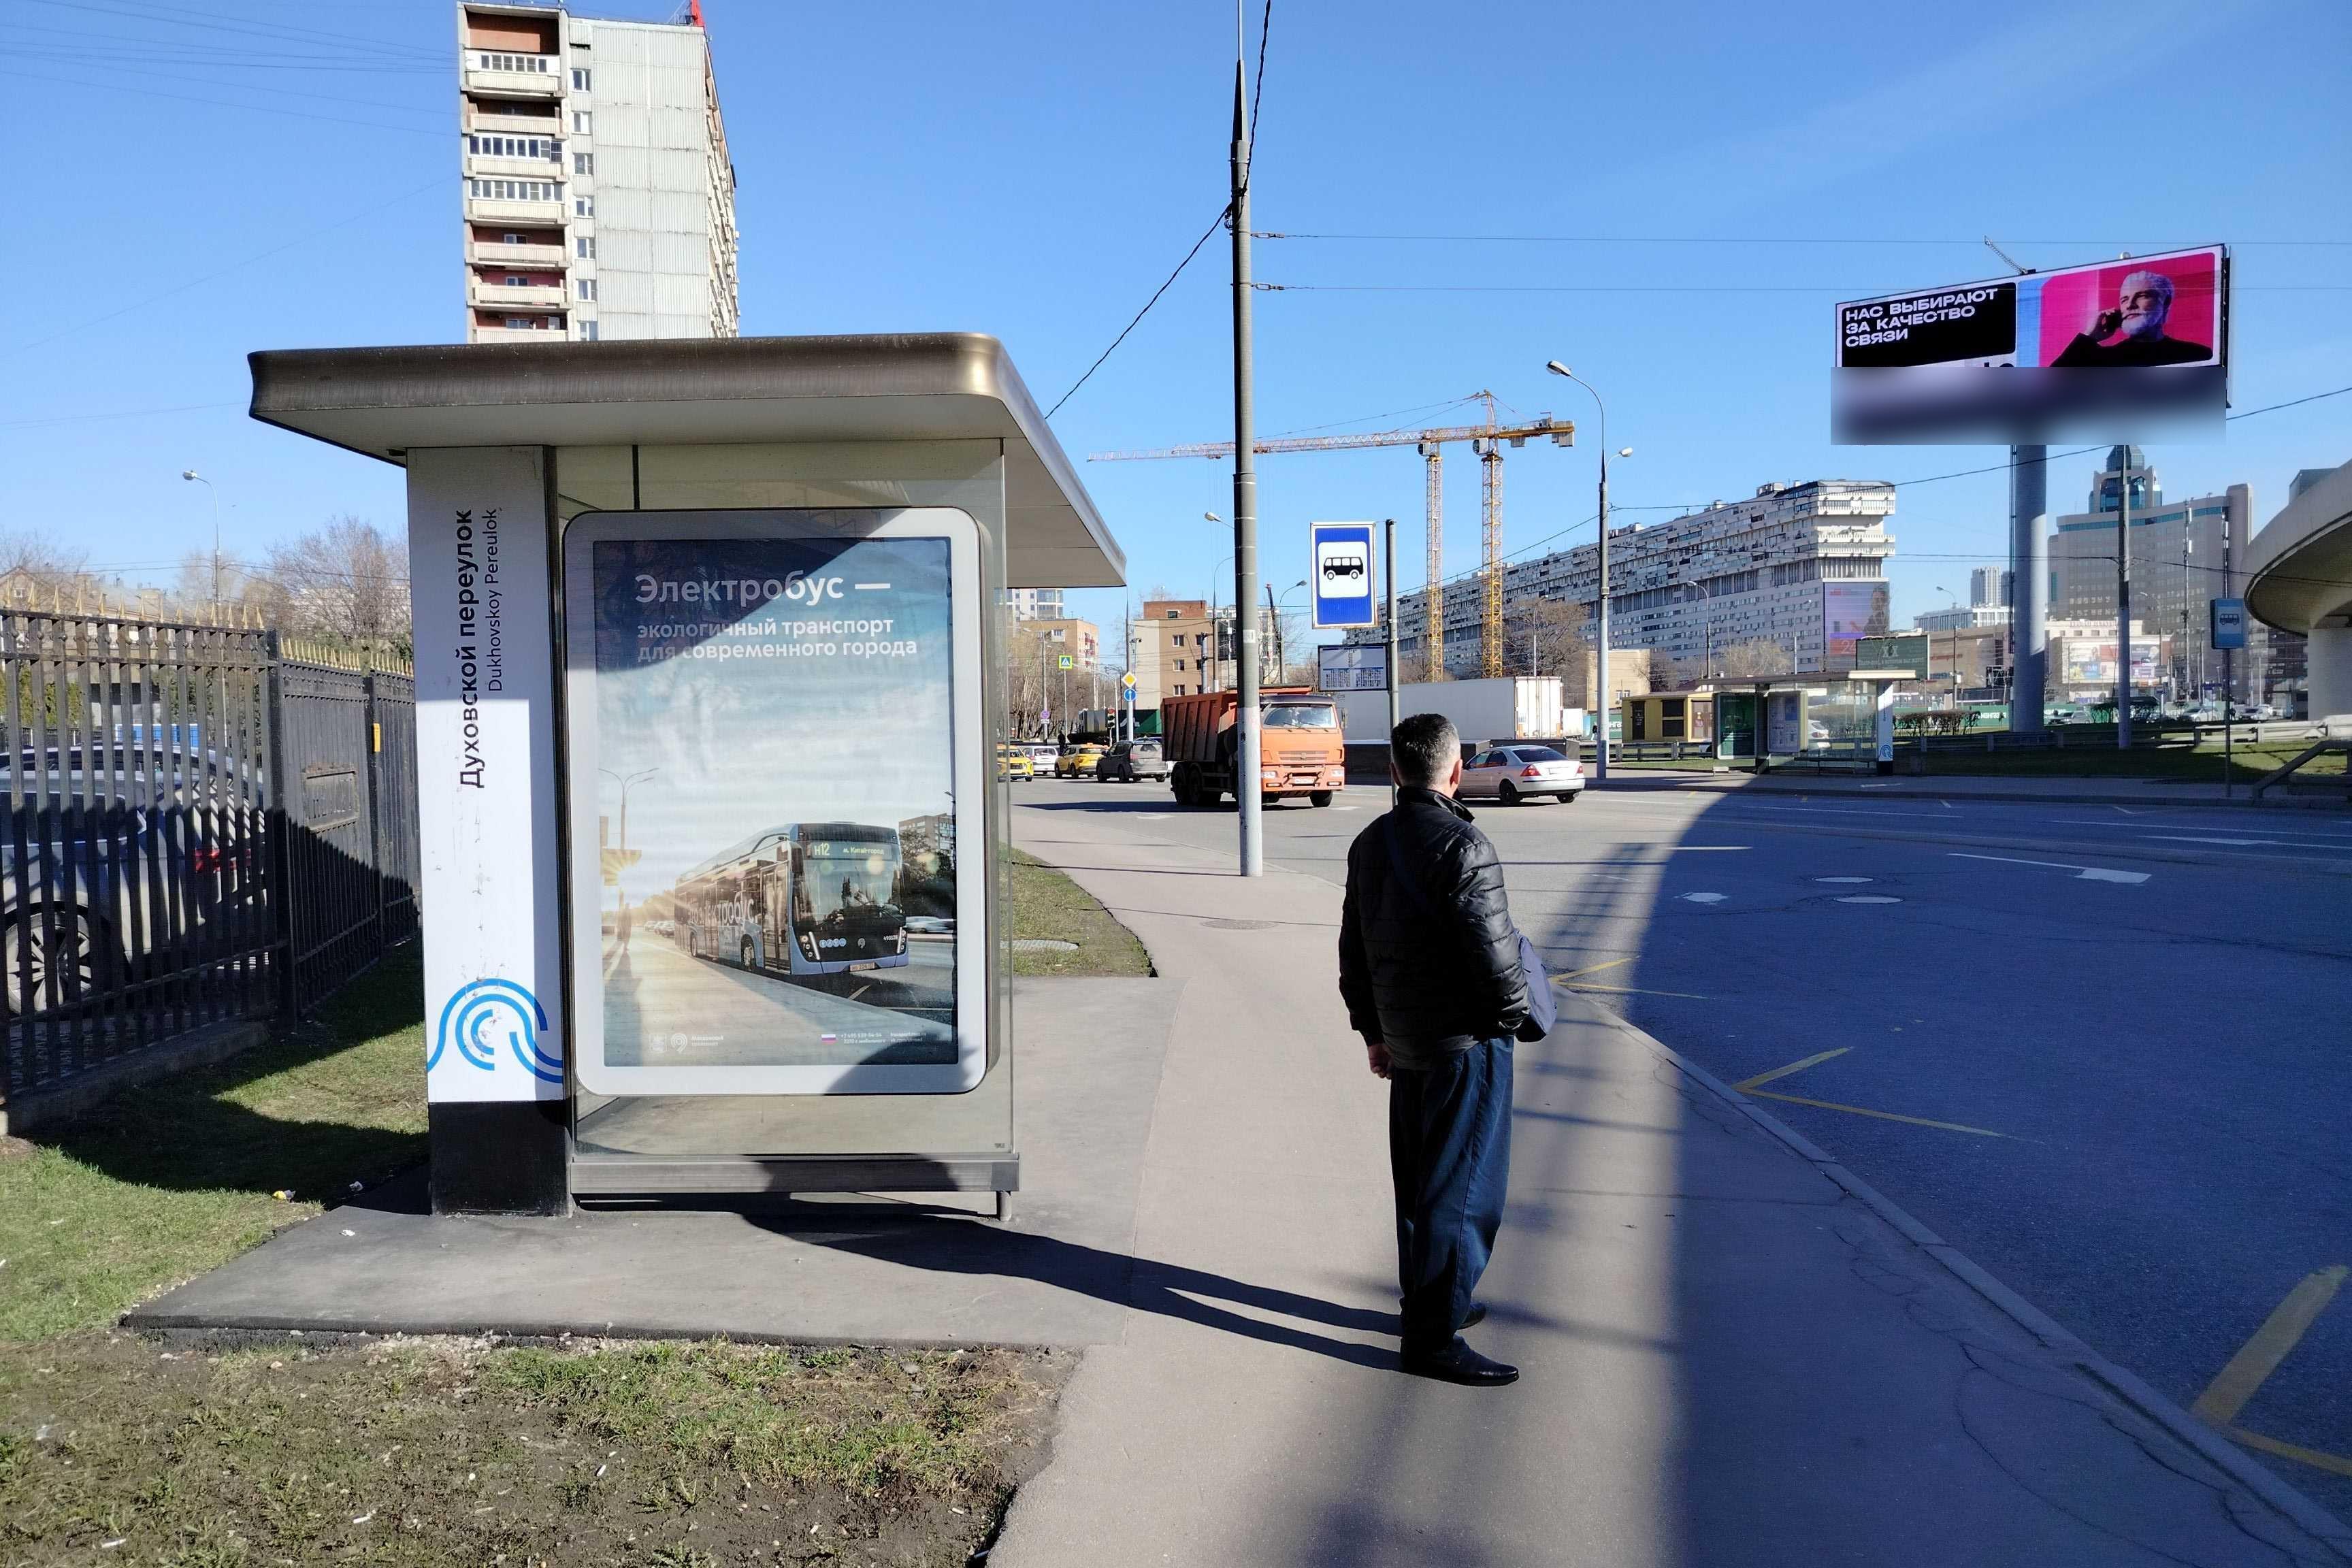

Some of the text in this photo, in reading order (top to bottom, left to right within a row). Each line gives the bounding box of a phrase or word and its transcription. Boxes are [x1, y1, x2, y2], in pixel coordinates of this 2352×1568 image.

[1846, 288, 1998, 322] НАС ВЫБИРАЮТ
[1846, 306, 1976, 335] ЗА КАЧЕСТВО
[1845, 328, 1908, 348] СВЯЗИ
[482, 508, 503, 691] Dukhovskoy Pereulok
[635, 570, 845, 607] Электробус
[637, 618, 894, 639] экологичный транспорт
[455, 509, 485, 789] Духовской переулок
[637, 640, 917, 663] для современного города
